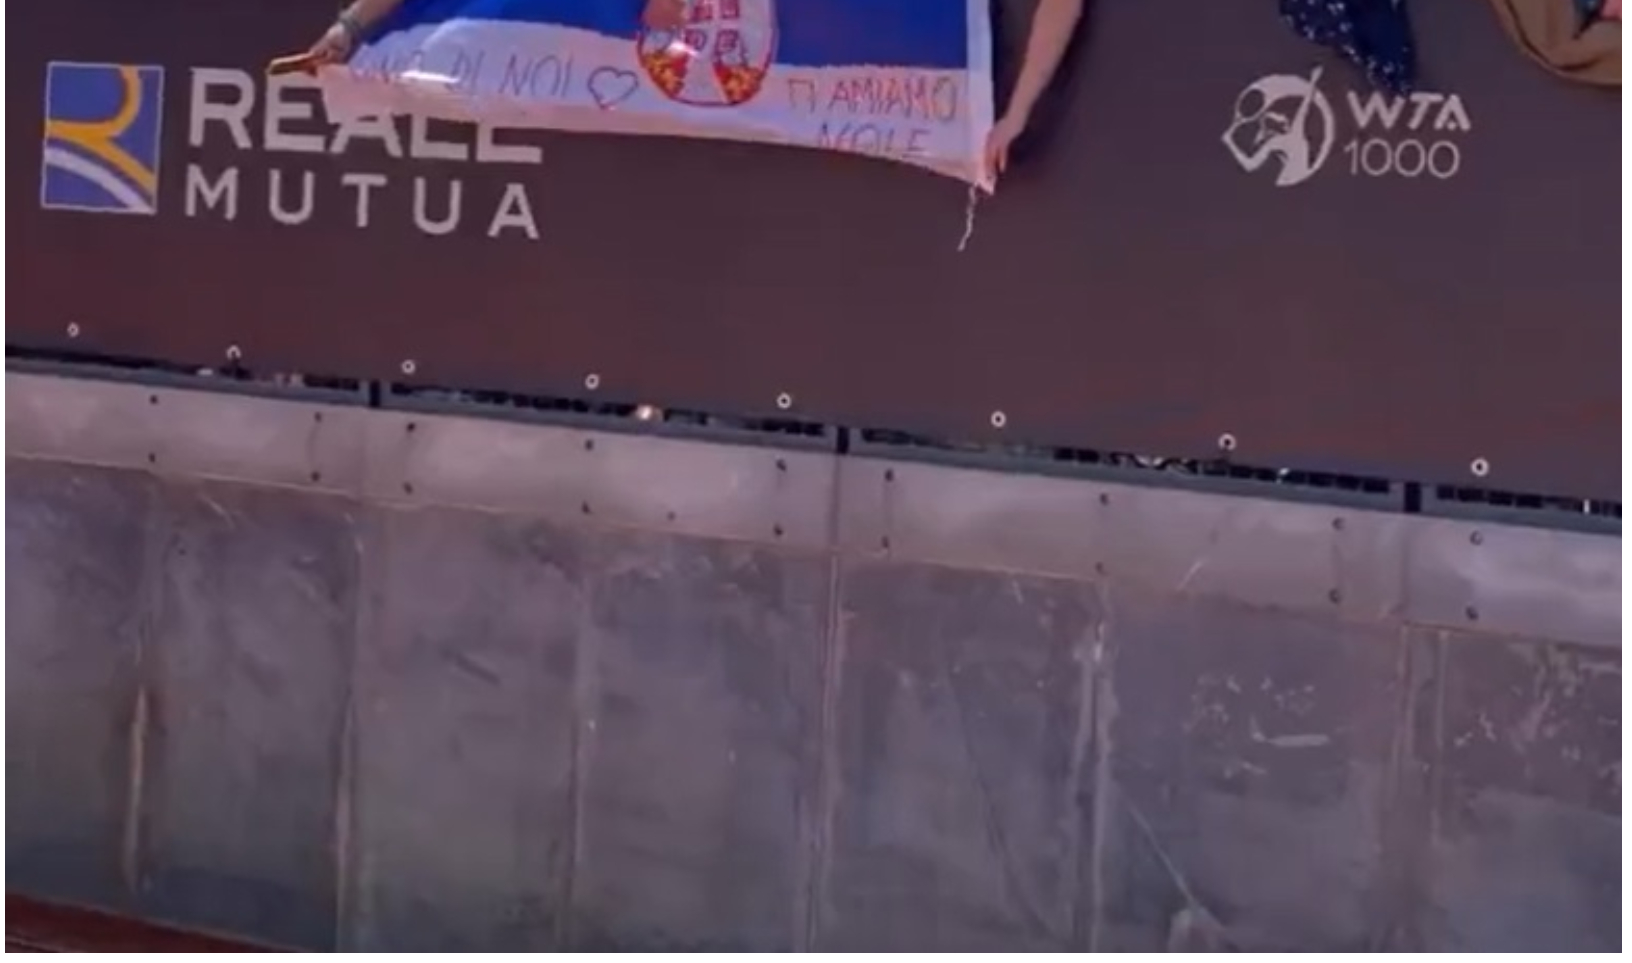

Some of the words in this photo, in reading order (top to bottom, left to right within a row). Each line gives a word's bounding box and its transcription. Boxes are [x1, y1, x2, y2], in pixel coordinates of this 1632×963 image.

[829, 75, 958, 123] AMIAMO
[1347, 90, 1472, 131] WTA
[1343, 137, 1461, 179] 1000
[184, 163, 540, 239] MUTUA
